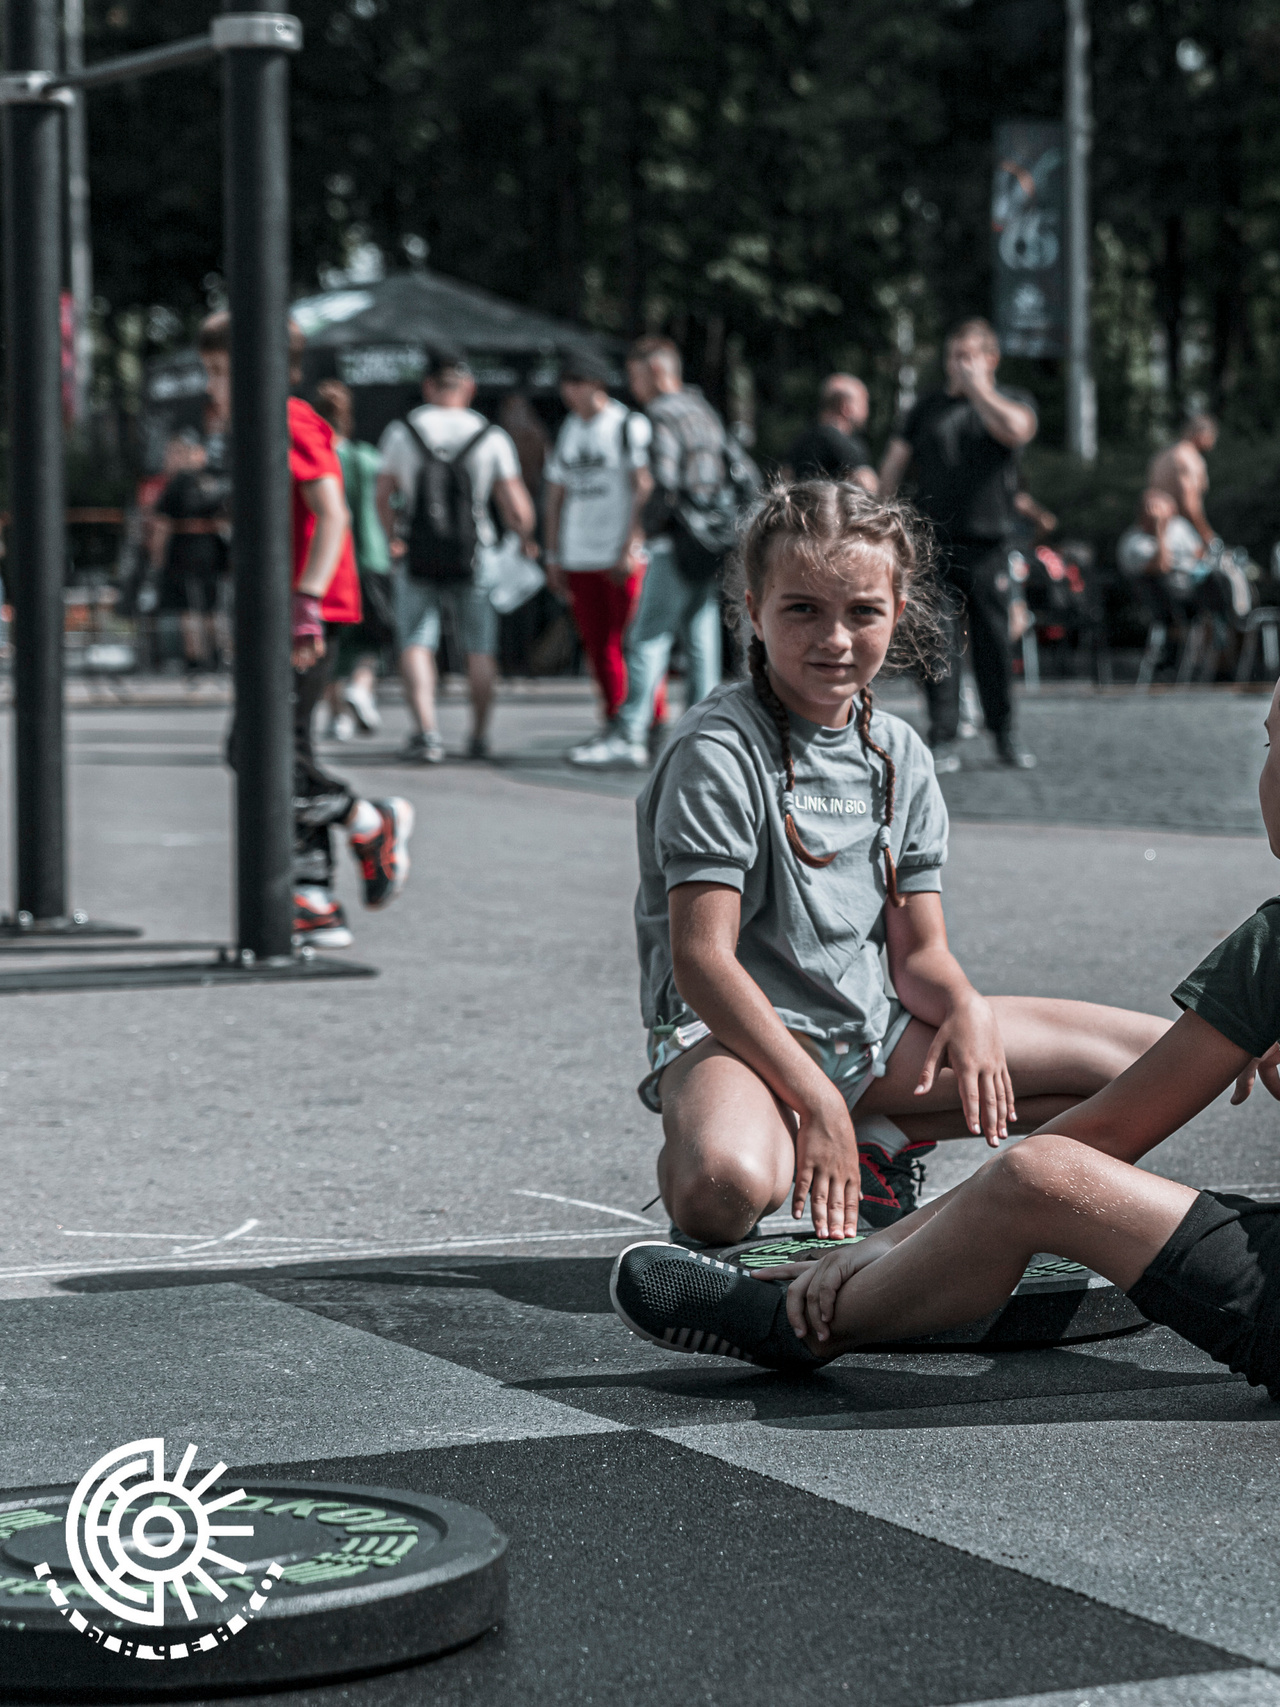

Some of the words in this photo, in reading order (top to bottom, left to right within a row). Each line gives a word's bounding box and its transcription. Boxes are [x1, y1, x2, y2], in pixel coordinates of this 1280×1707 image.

[795, 795, 828, 812] LINK
[830, 797, 844, 814] IN
[845, 799, 867, 815] BIO
